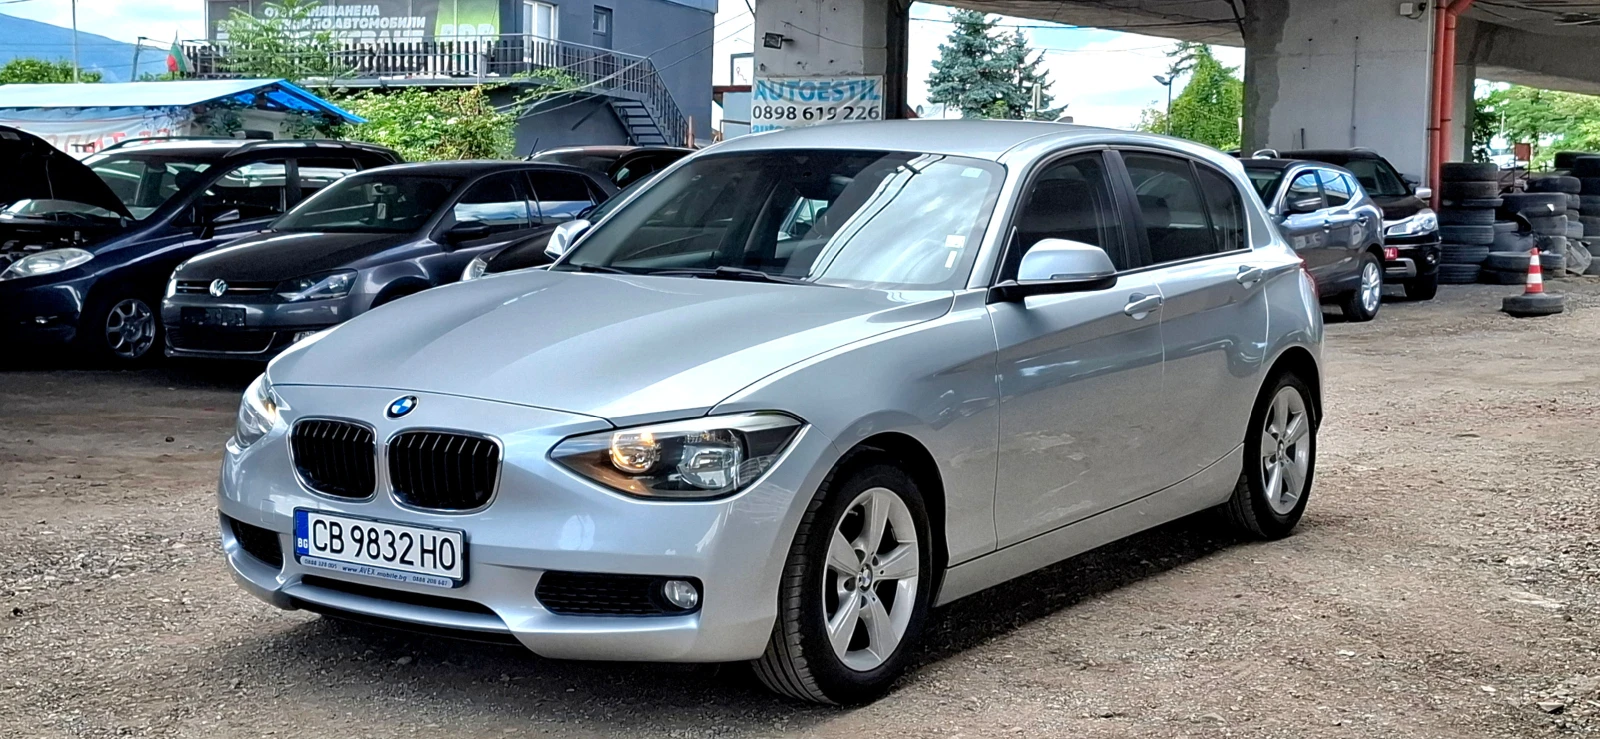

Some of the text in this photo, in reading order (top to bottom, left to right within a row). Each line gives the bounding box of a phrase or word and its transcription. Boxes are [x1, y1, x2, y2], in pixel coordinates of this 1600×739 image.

[362, 5, 380, 16] НА
[334, 17, 426, 29] АВТОМОБИЛИ
[754, 79, 880, 102] AUTOESTIL
[753, 105, 880, 120] 0898 619 226
[297, 537, 309, 549] BG
[313, 519, 345, 554] CB
[350, 525, 414, 566] 9832
